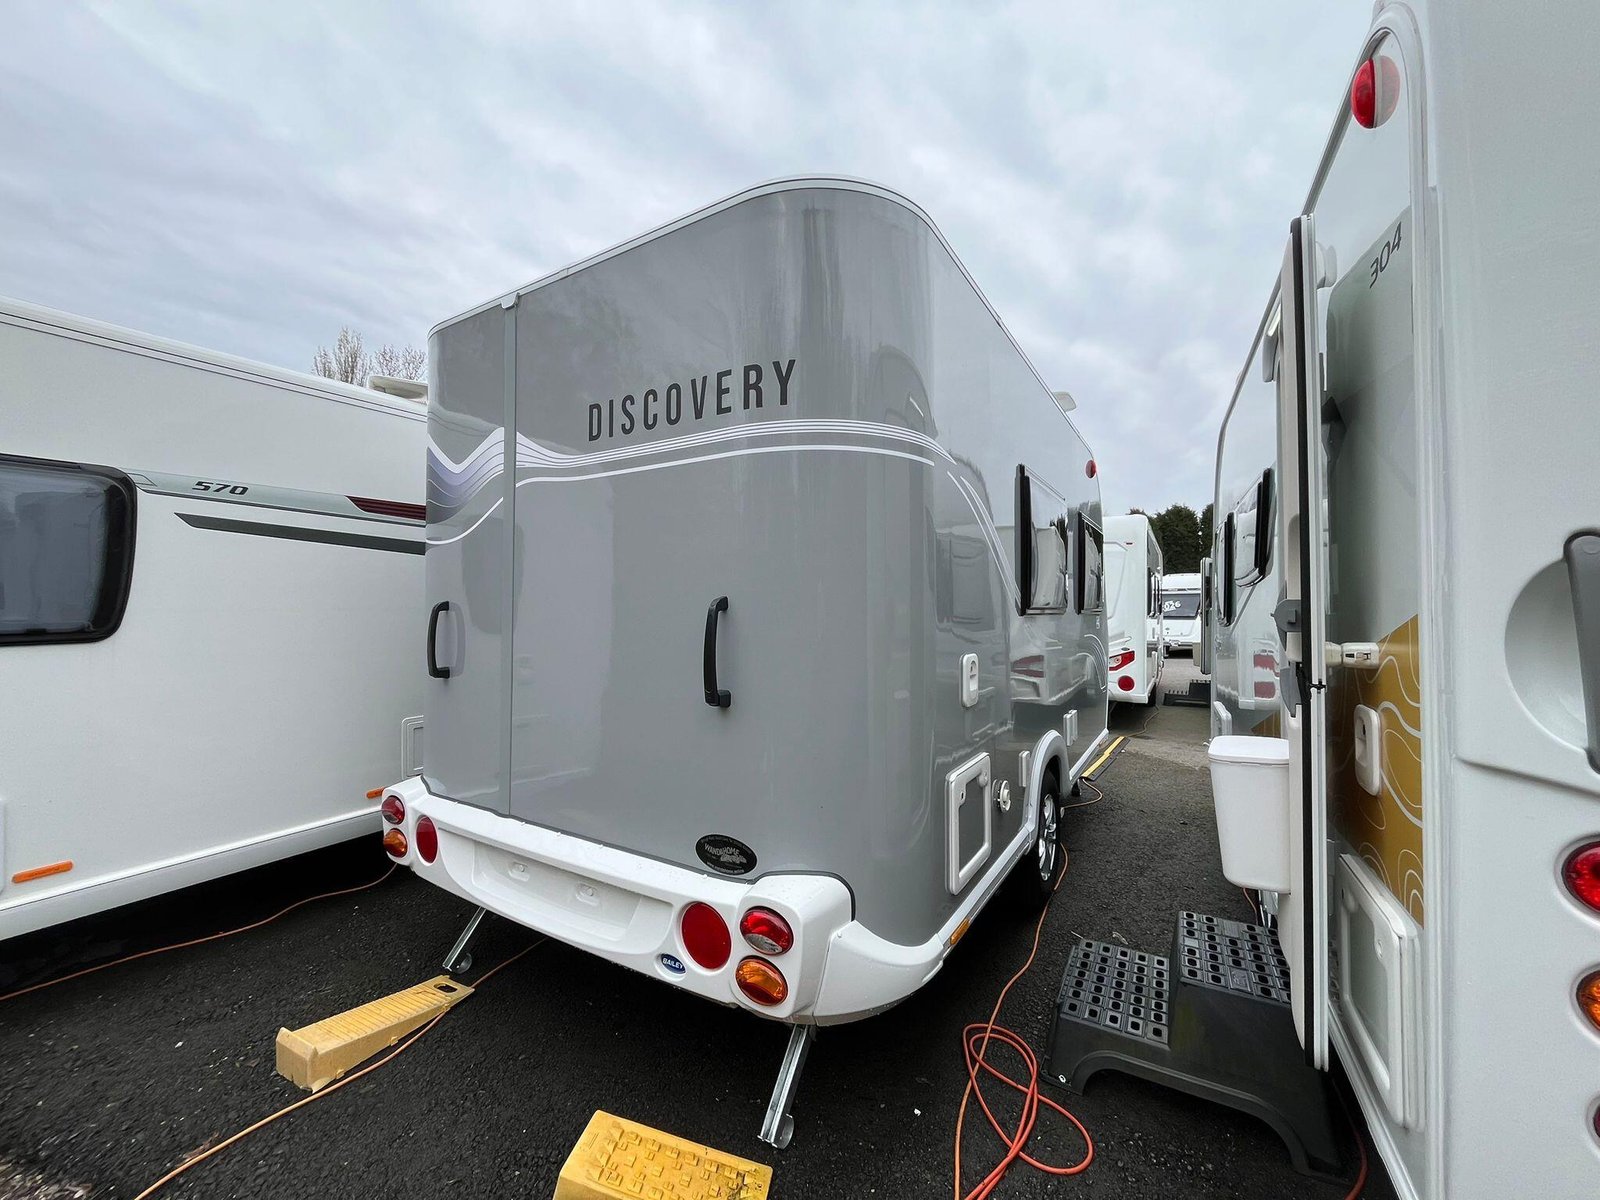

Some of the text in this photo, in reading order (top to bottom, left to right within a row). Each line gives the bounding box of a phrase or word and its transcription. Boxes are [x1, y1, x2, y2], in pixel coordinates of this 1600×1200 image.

[1369, 221, 1402, 289] 304
[588, 359, 796, 442] DISCOVERY
[192, 480, 249, 496] 570
[662, 957, 684, 969] BAILEY
